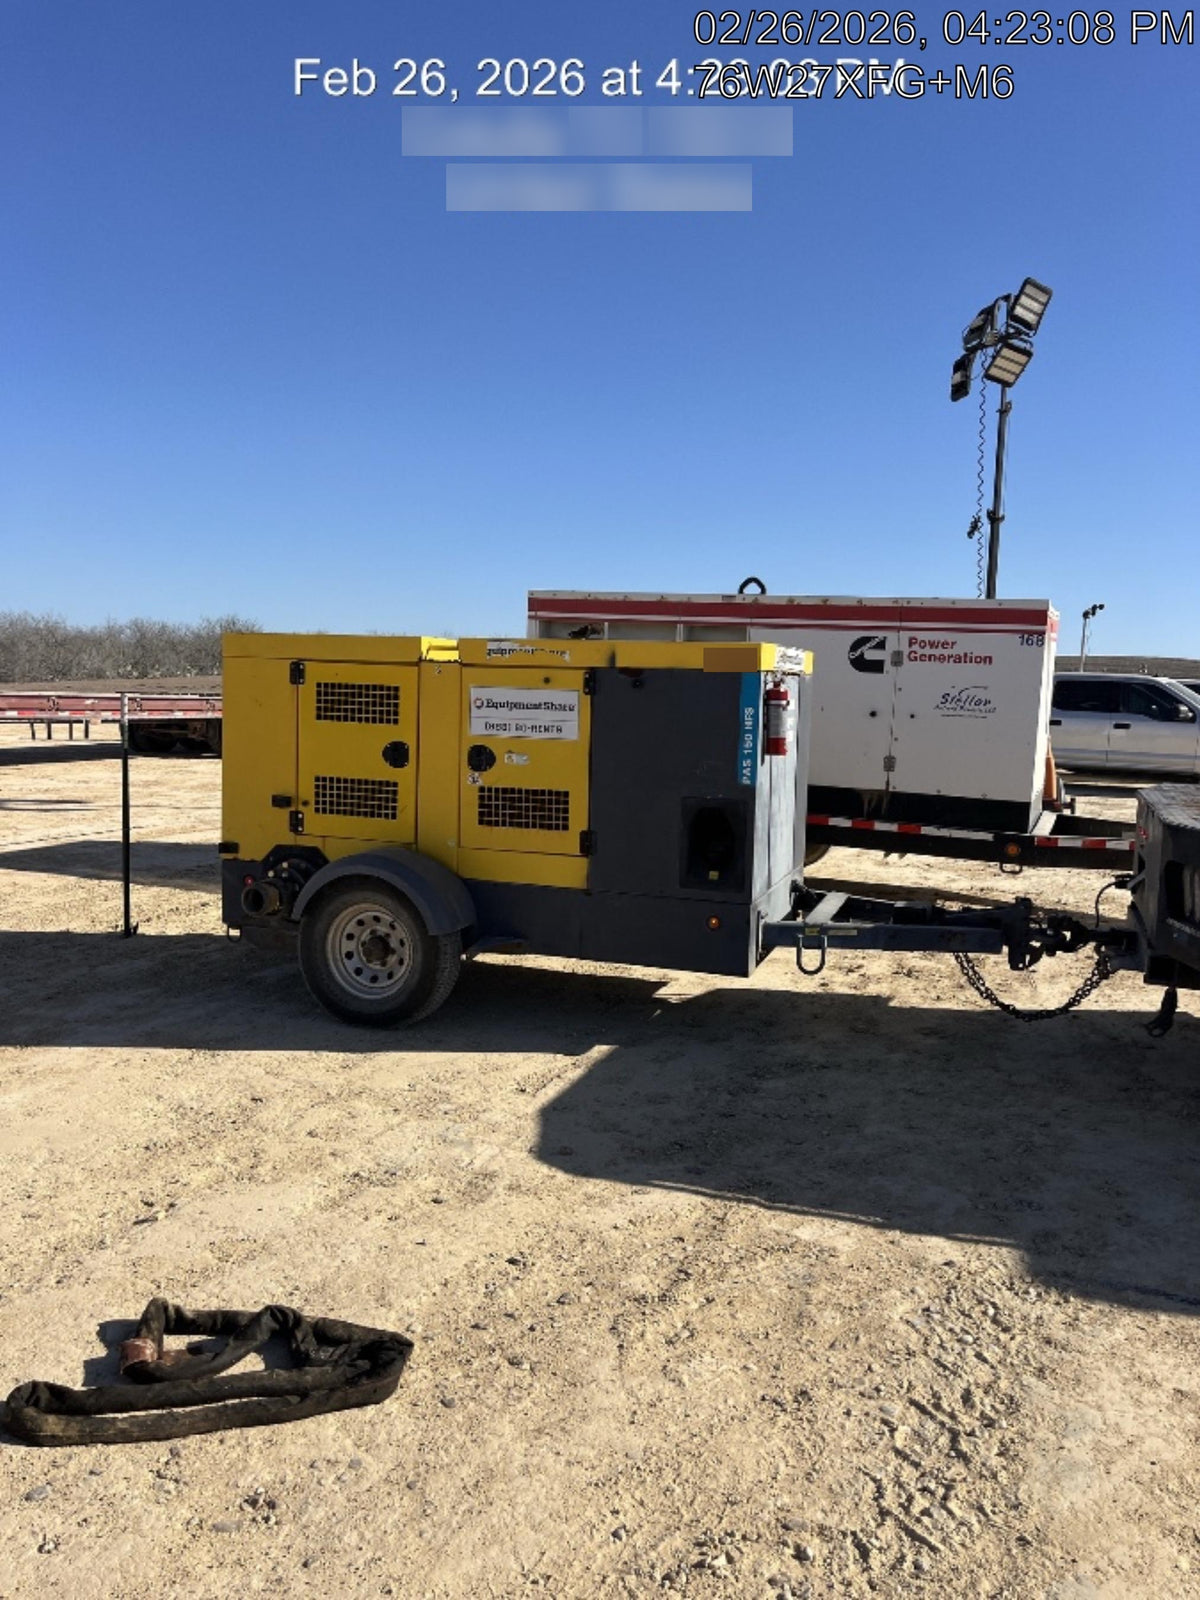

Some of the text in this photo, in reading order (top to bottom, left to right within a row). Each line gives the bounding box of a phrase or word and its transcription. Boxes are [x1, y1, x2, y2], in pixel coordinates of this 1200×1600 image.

[908, 636, 957, 650] Power
[1018, 634, 1045, 648] 168
[907, 651, 993, 665] Generation
[485, 698, 576, 712] EquipmentShare
[743, 735, 753, 754] 150
[742, 760, 753, 785] PAS
